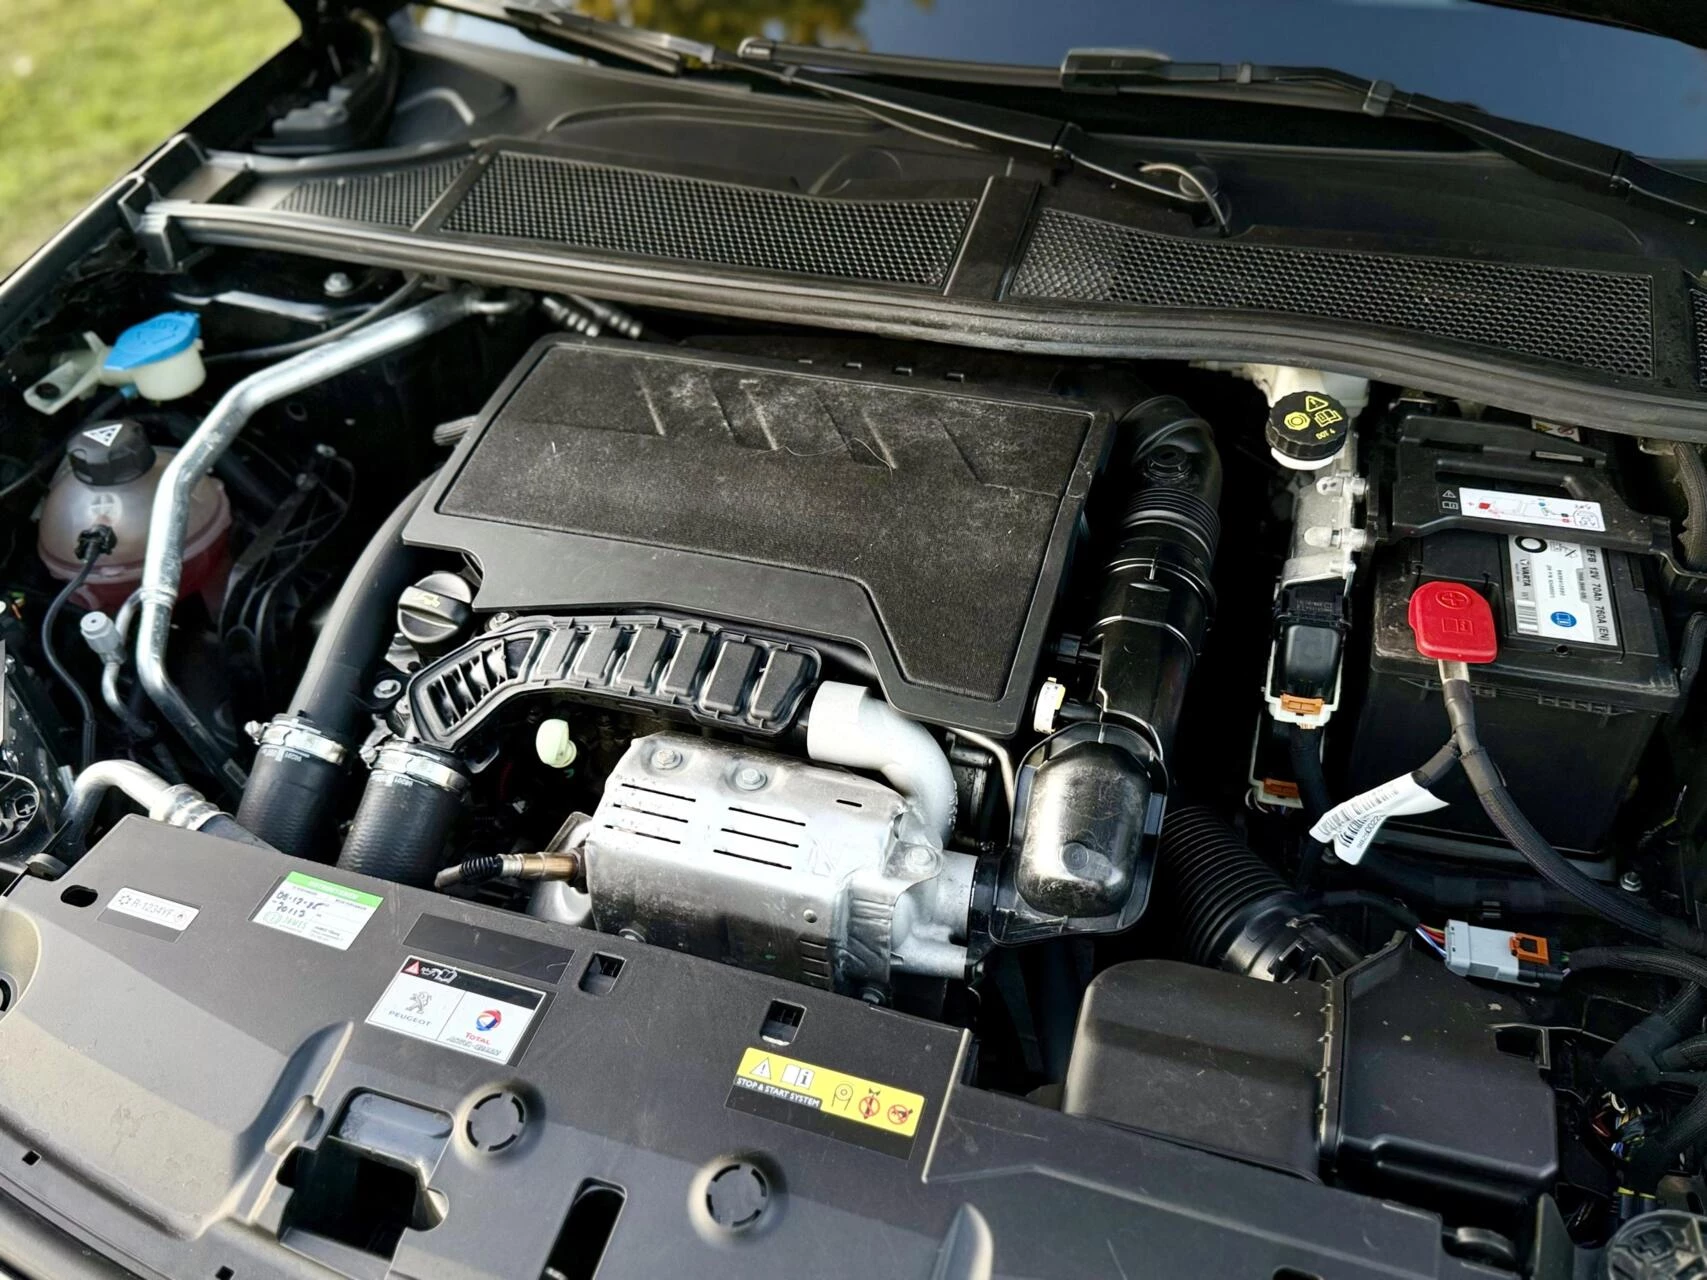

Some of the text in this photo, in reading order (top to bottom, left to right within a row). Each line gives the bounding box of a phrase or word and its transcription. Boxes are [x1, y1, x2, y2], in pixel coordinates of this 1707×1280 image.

[1315, 430, 1329, 439] DOT
[1521, 565, 1531, 587] VARTA
[1589, 567, 1600, 580] 12V
[1592, 584, 1603, 601] 70Ah
[1597, 625, 1610, 641] (EN)
[388, 1010, 432, 1027] PEUGEOT
[465, 1032, 491, 1045] TOTAL
[737, 1077, 820, 1106] STOP & START SYSTEM
